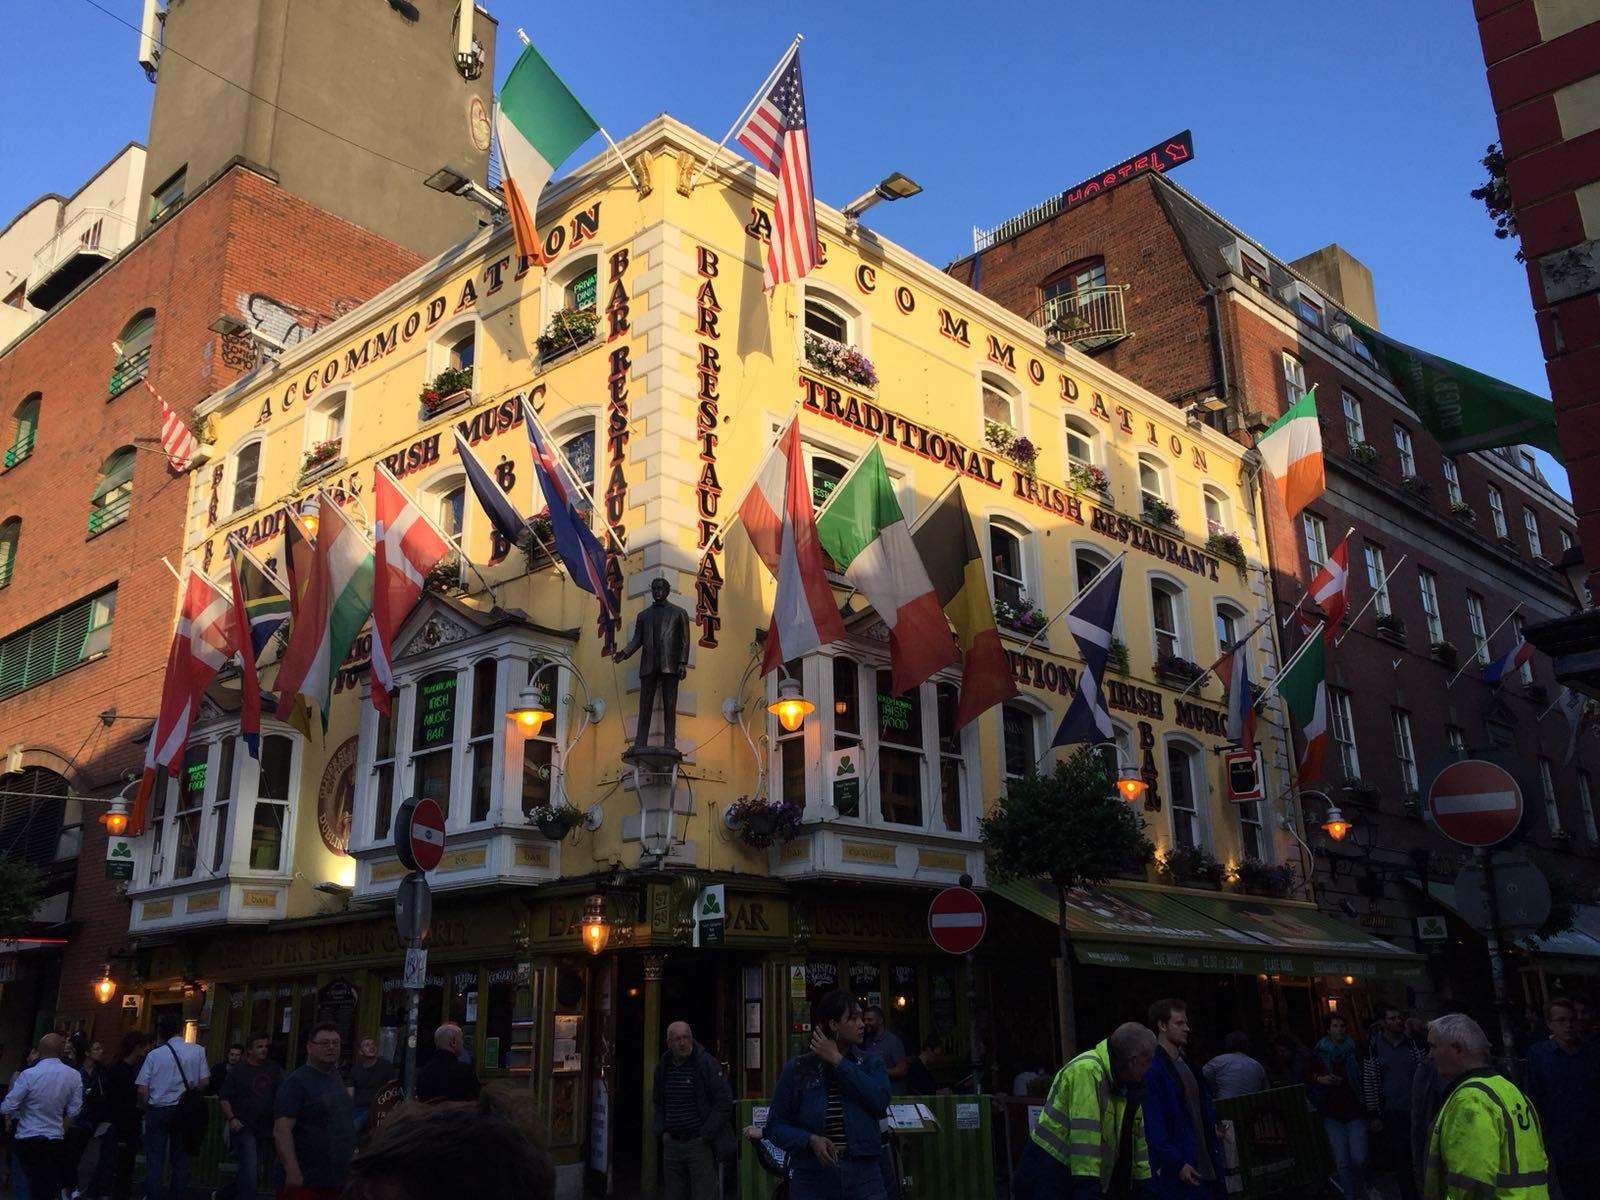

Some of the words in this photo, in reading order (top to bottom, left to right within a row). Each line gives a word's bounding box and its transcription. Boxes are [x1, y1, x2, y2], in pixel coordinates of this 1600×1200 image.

[574, 273, 597, 294] PRIVAT
[577, 285, 597, 302] DINI
[607, 248, 631, 343] BAR
[695, 244, 721, 339] BAR
[373, 433, 440, 491] RISH
[454, 383, 547, 454] MUSIC
[799, 375, 1003, 488] TRADITIONAL
[1013, 471, 1085, 525] IRISH
[1090, 505, 1220, 582] RESTAURANT
[208, 463, 223, 529] BAR
[696, 342, 724, 648] RESTAURANT
[1107, 680, 1164, 720] IRISH
[1137, 721, 1161, 812] BAR
[725, 902, 770, 931] AR
